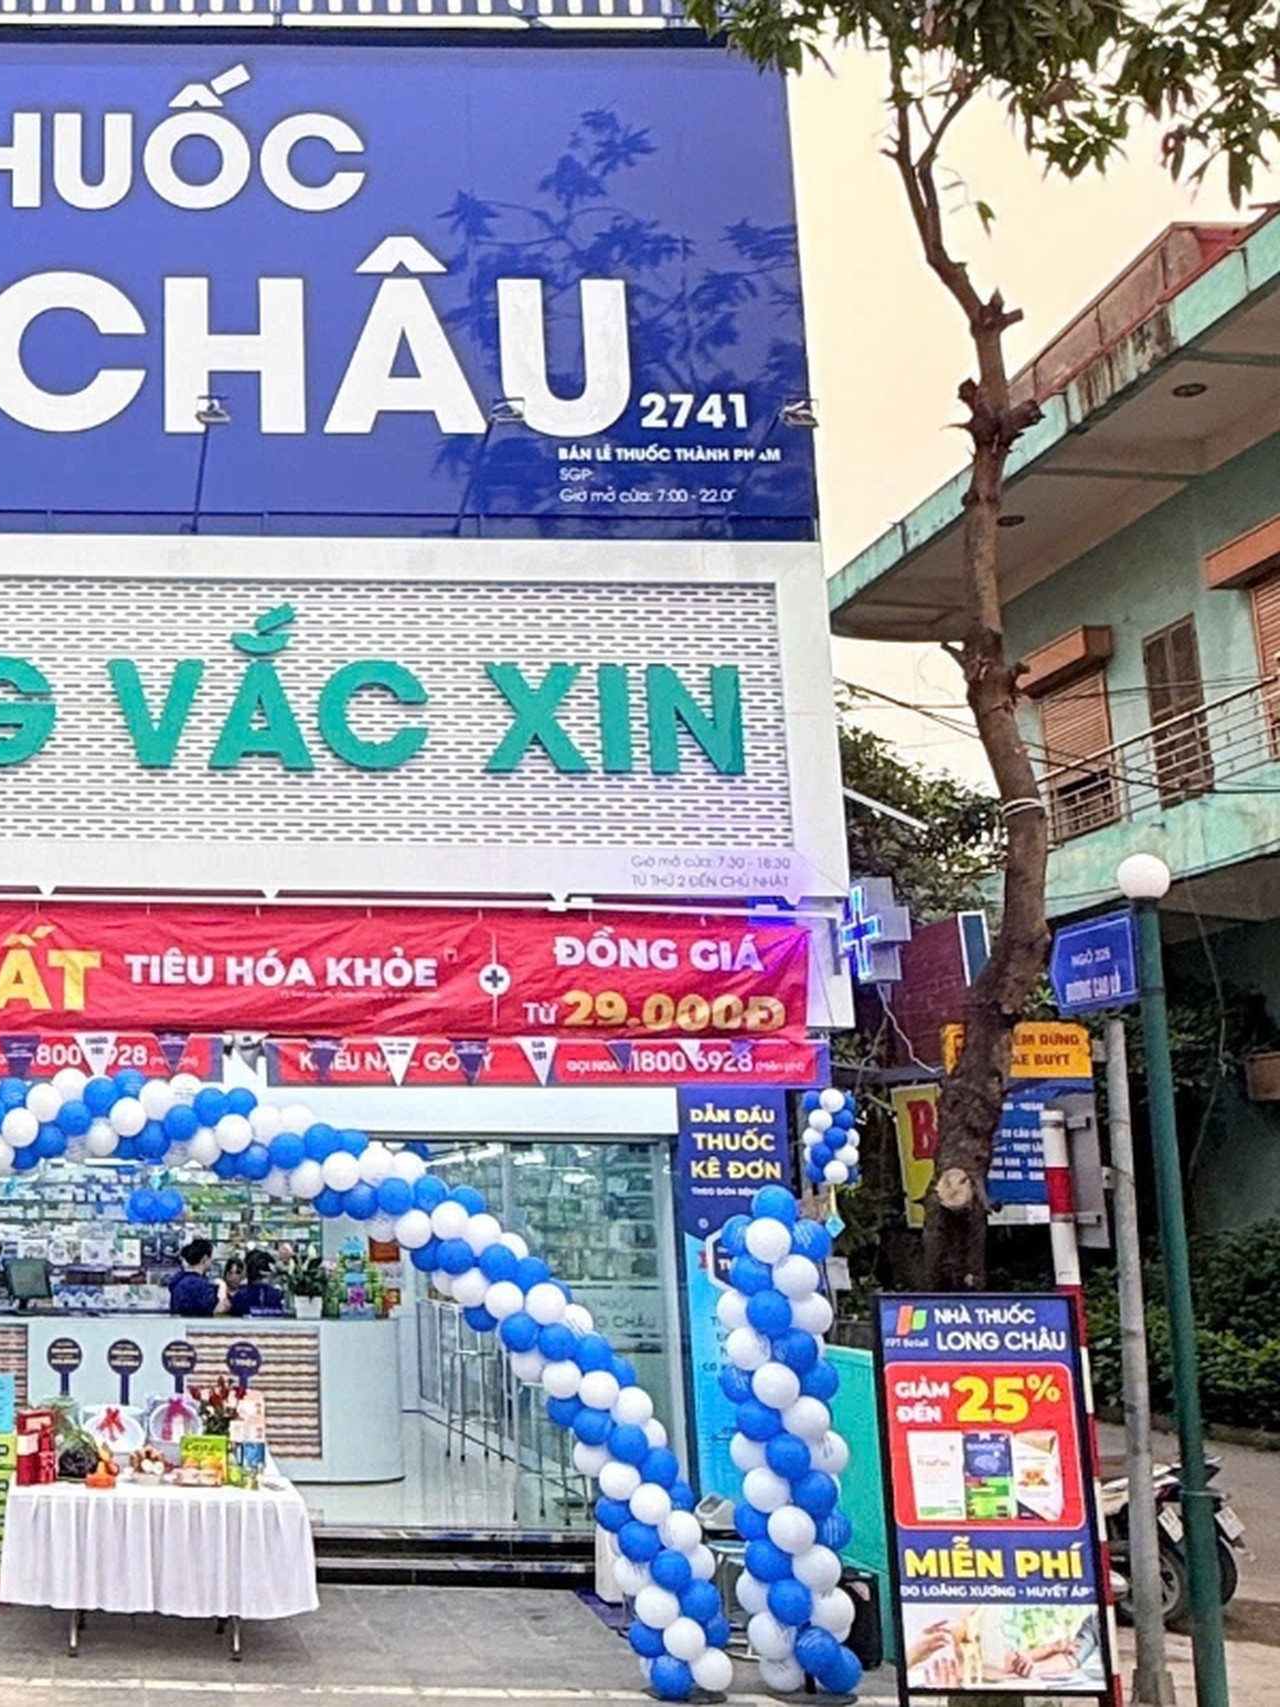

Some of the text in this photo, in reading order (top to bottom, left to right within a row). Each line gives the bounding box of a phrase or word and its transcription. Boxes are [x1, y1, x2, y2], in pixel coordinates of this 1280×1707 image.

[639, 392, 748, 428] 2741
[106, 602, 430, 772] VẮC
[483, 662, 747, 776] XIN
[124, 946, 438, 988] TIÊU HÓA KHỎE
[552, 926, 765, 973] ĐỒNG GIÁ
[522, 989, 787, 1032] TỪ 29.000Đ
[689, 1102, 730, 1124] DẪN
[691, 1127, 777, 1152] THUỐC
[690, 1156, 783, 1180] KÊ ĐƠN
[933, 1302, 1036, 1325] NHÀ THUỐC
[936, 1327, 1067, 1351] LONG CHÂU
[894, 1374, 1061, 1424] GIẢM 25%
[896, 1401, 942, 1423] ĐẾN
[904, 1535, 1083, 1579] MIỄN PHÍ
